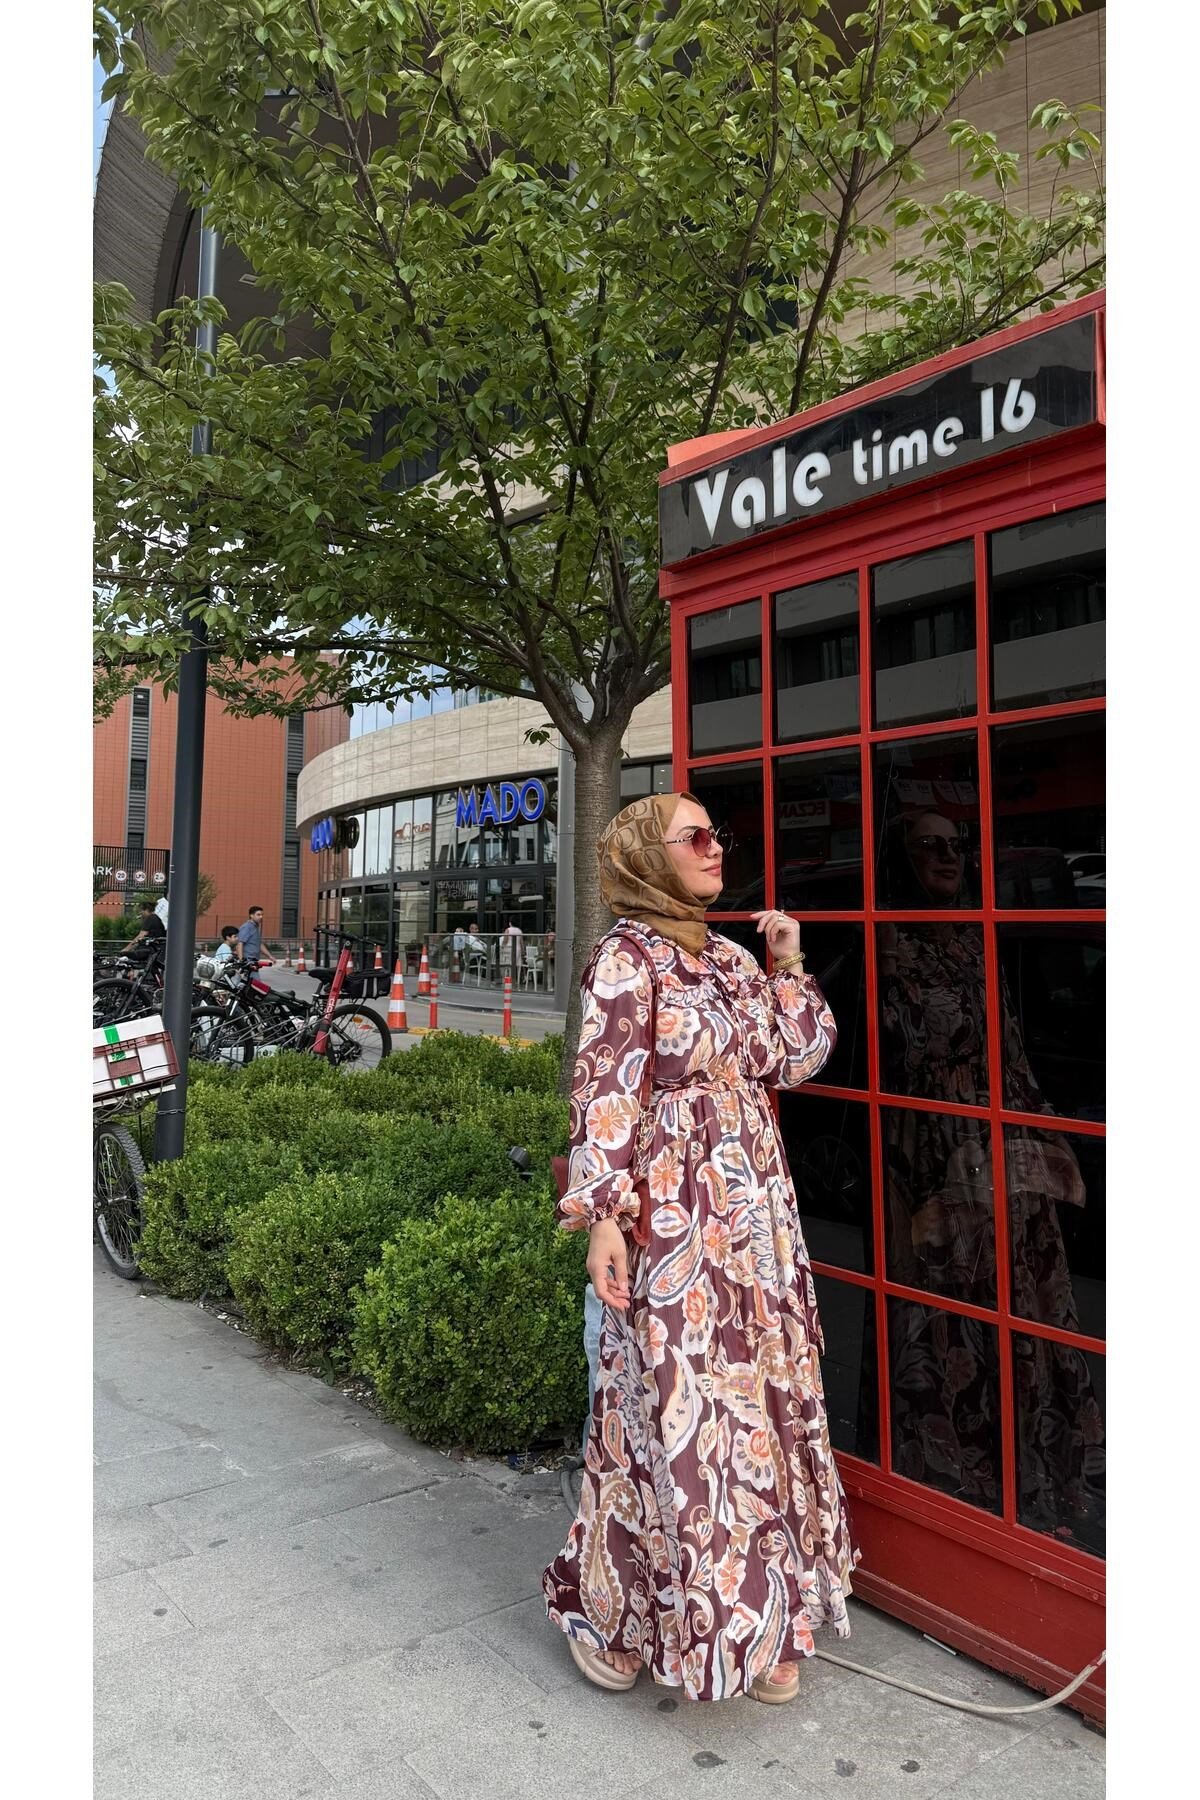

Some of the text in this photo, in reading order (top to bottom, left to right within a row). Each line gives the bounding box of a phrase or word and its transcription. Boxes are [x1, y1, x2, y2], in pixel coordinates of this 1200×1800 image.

[694, 378, 1036, 541] Vale time 16
[455, 778, 546, 829] MADO
